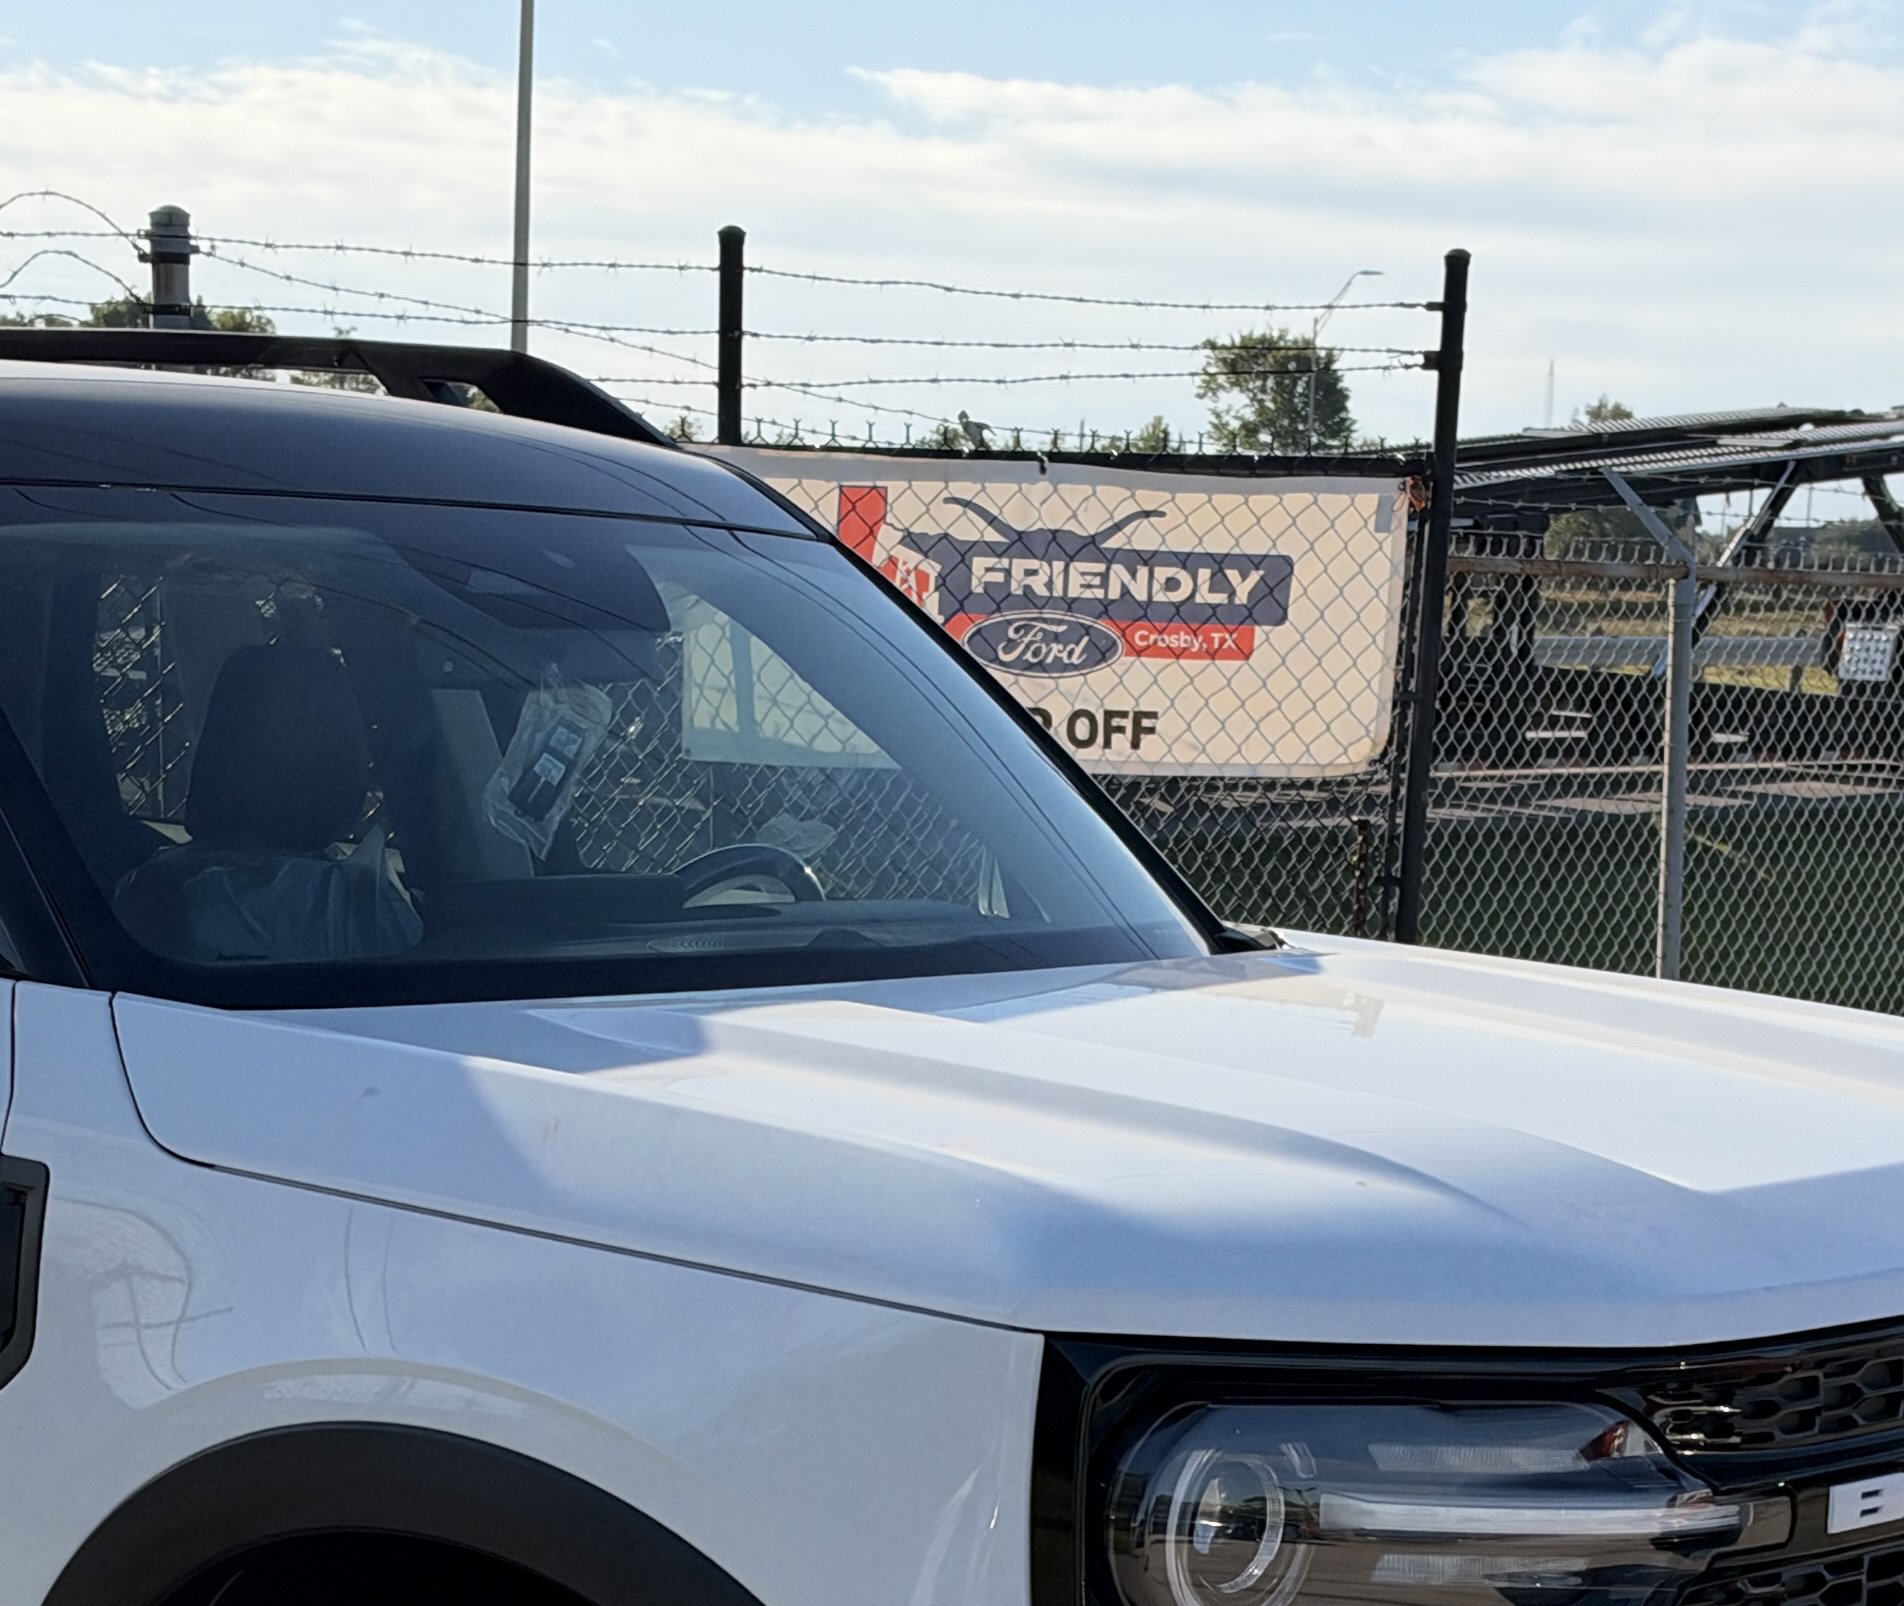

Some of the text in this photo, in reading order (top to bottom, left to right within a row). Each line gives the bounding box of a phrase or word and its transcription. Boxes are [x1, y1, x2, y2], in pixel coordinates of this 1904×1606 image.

[969, 555, 1266, 606] FRIENDLY
[996, 619, 1090, 665] Ford
[1133, 628, 1238, 652] Crosby, TX
[1066, 708, 1159, 751] OFF
